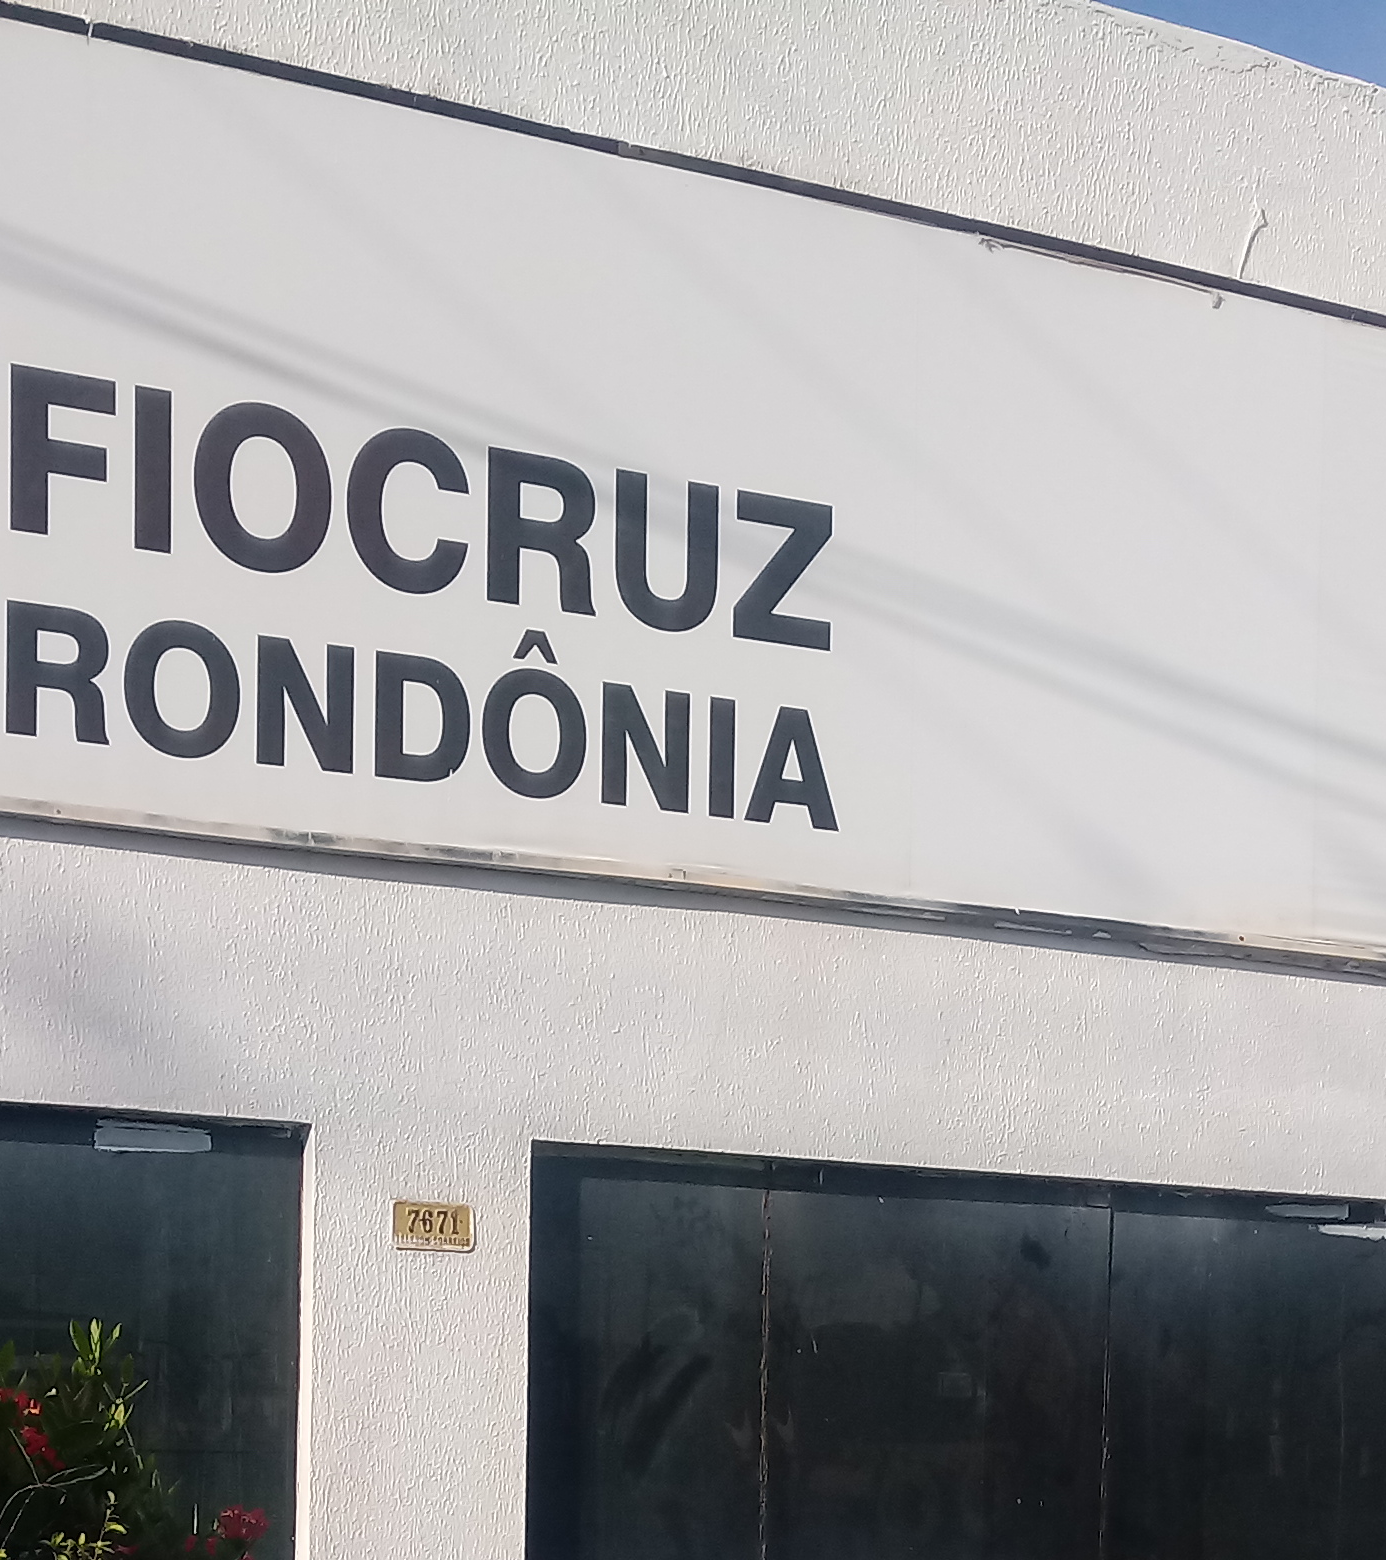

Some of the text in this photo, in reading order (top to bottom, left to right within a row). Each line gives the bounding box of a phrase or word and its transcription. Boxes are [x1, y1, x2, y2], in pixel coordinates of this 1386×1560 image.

[9, 362, 833, 651] FIOCRUZ
[5, 598, 840, 832] RONDÔNIA
[407, 1208, 460, 1235] 7671
